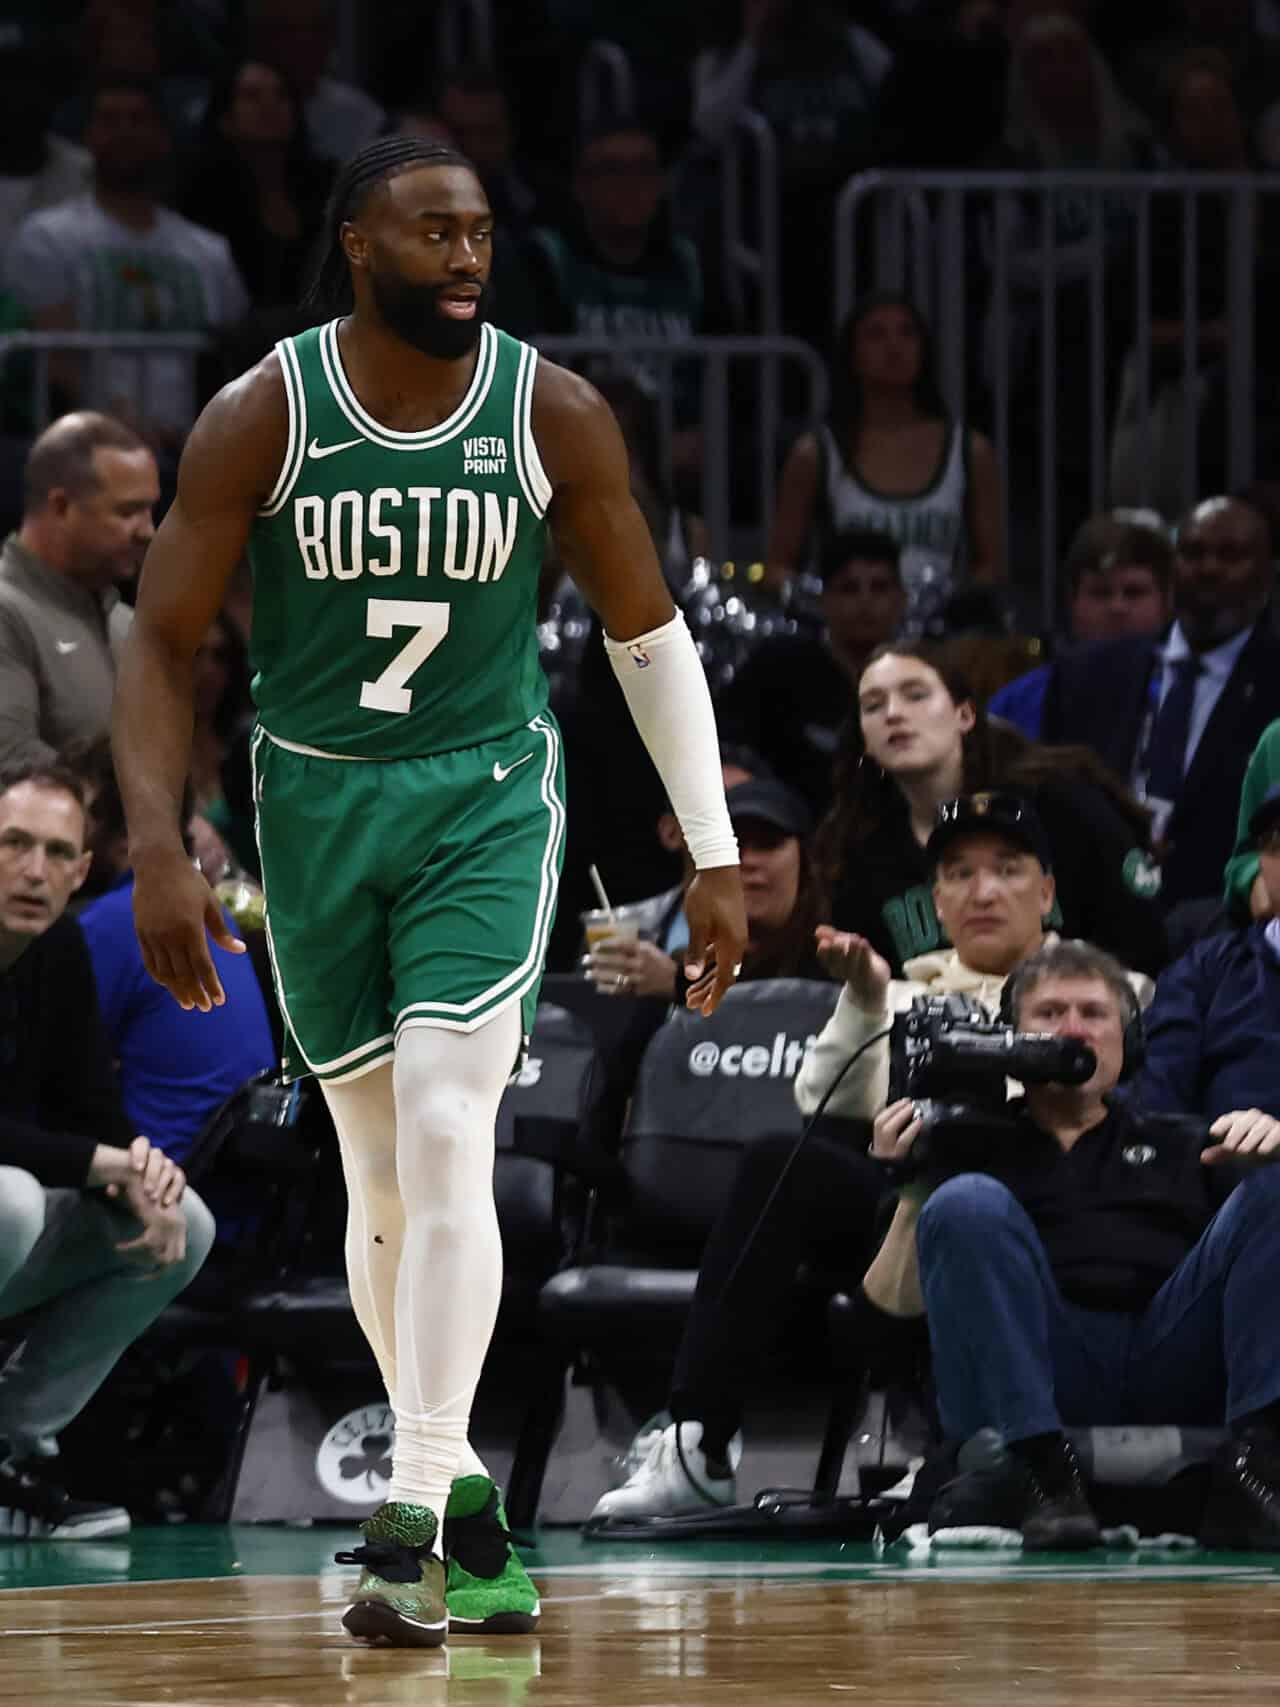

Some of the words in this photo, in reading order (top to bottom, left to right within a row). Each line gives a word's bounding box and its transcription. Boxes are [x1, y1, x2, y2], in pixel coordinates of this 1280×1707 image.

[463, 436, 507, 458] VISTA
[463, 458, 507, 475] PRINT
[294, 486, 519, 582] BOSTON
[359, 598, 451, 714] 7
